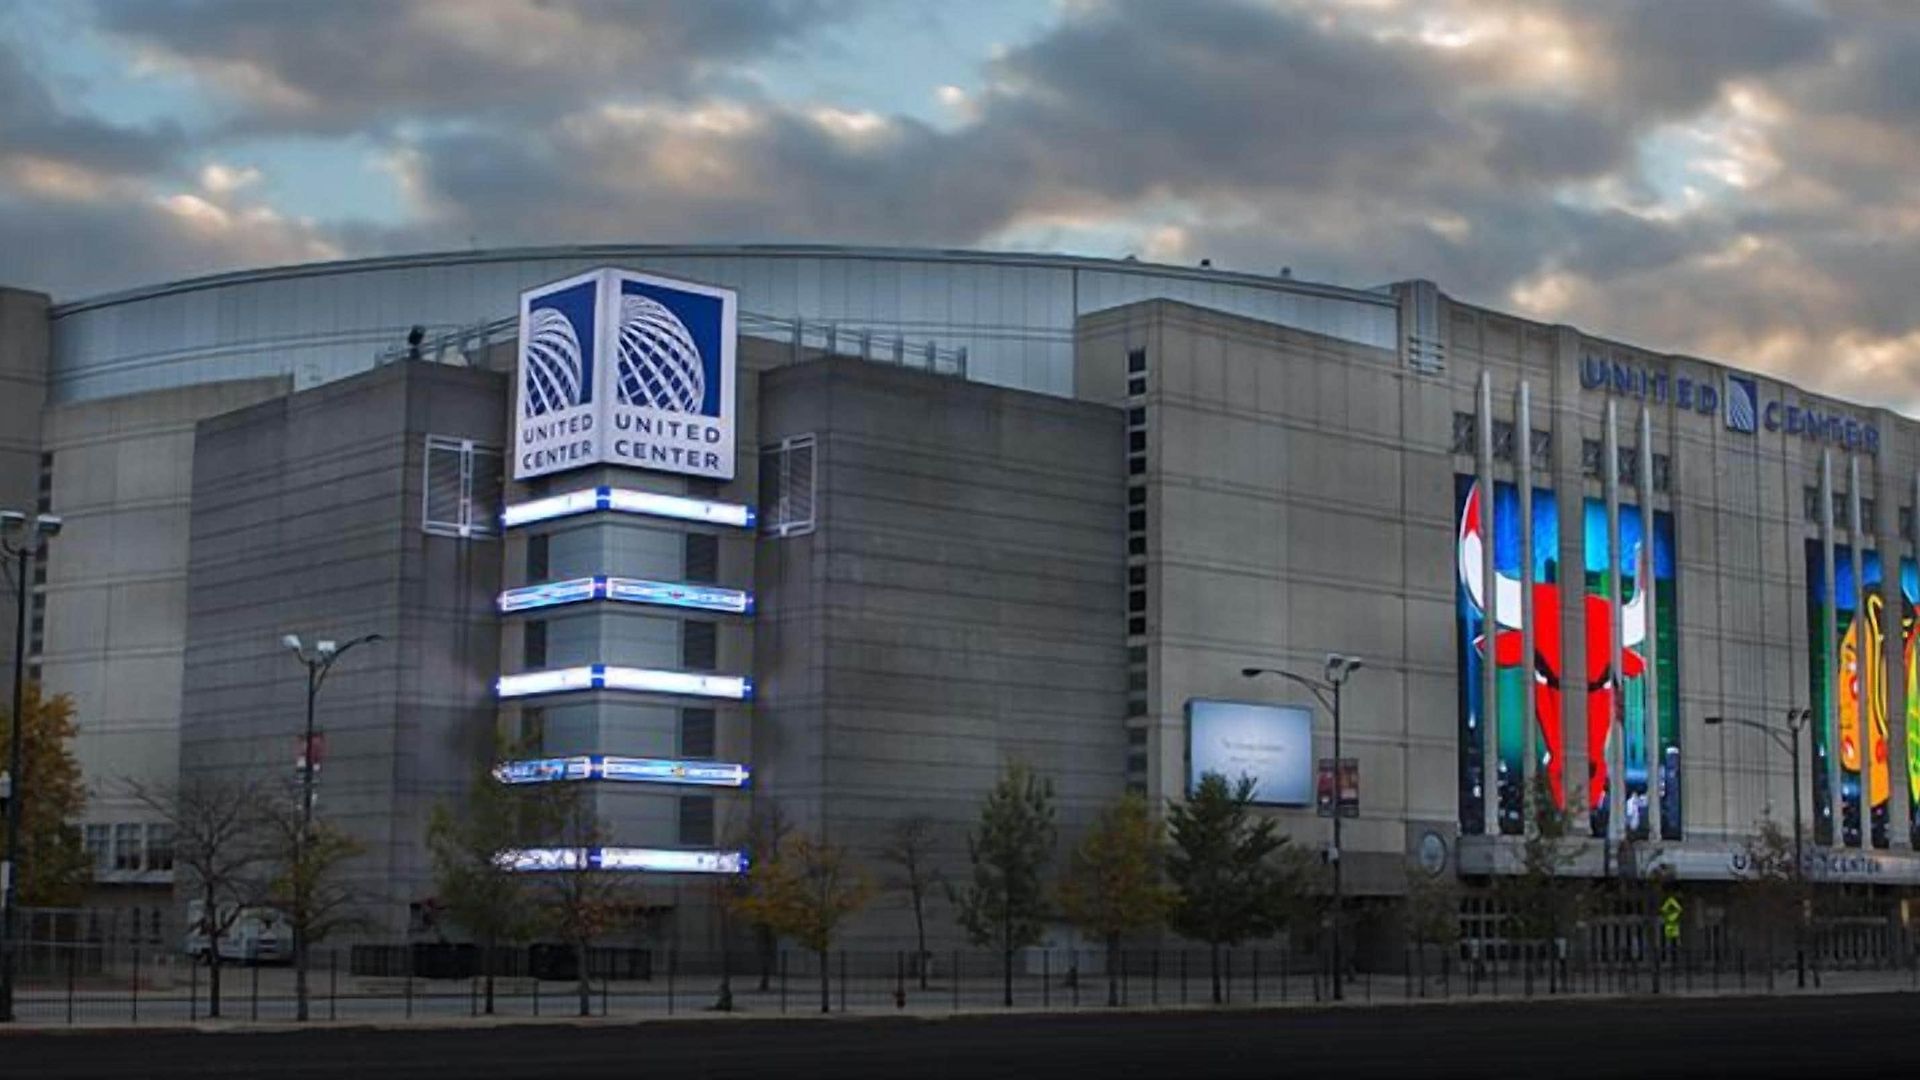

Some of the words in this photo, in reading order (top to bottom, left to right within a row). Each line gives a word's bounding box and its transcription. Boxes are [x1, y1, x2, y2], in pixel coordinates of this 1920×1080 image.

[1580, 355, 1718, 415] UNITED
[1764, 401, 1879, 453] CENTER
[523, 413, 593, 444] UNITED
[615, 413, 720, 443] UNITED
[522, 440, 592, 470] CENTER
[614, 440, 719, 470] CENTER
